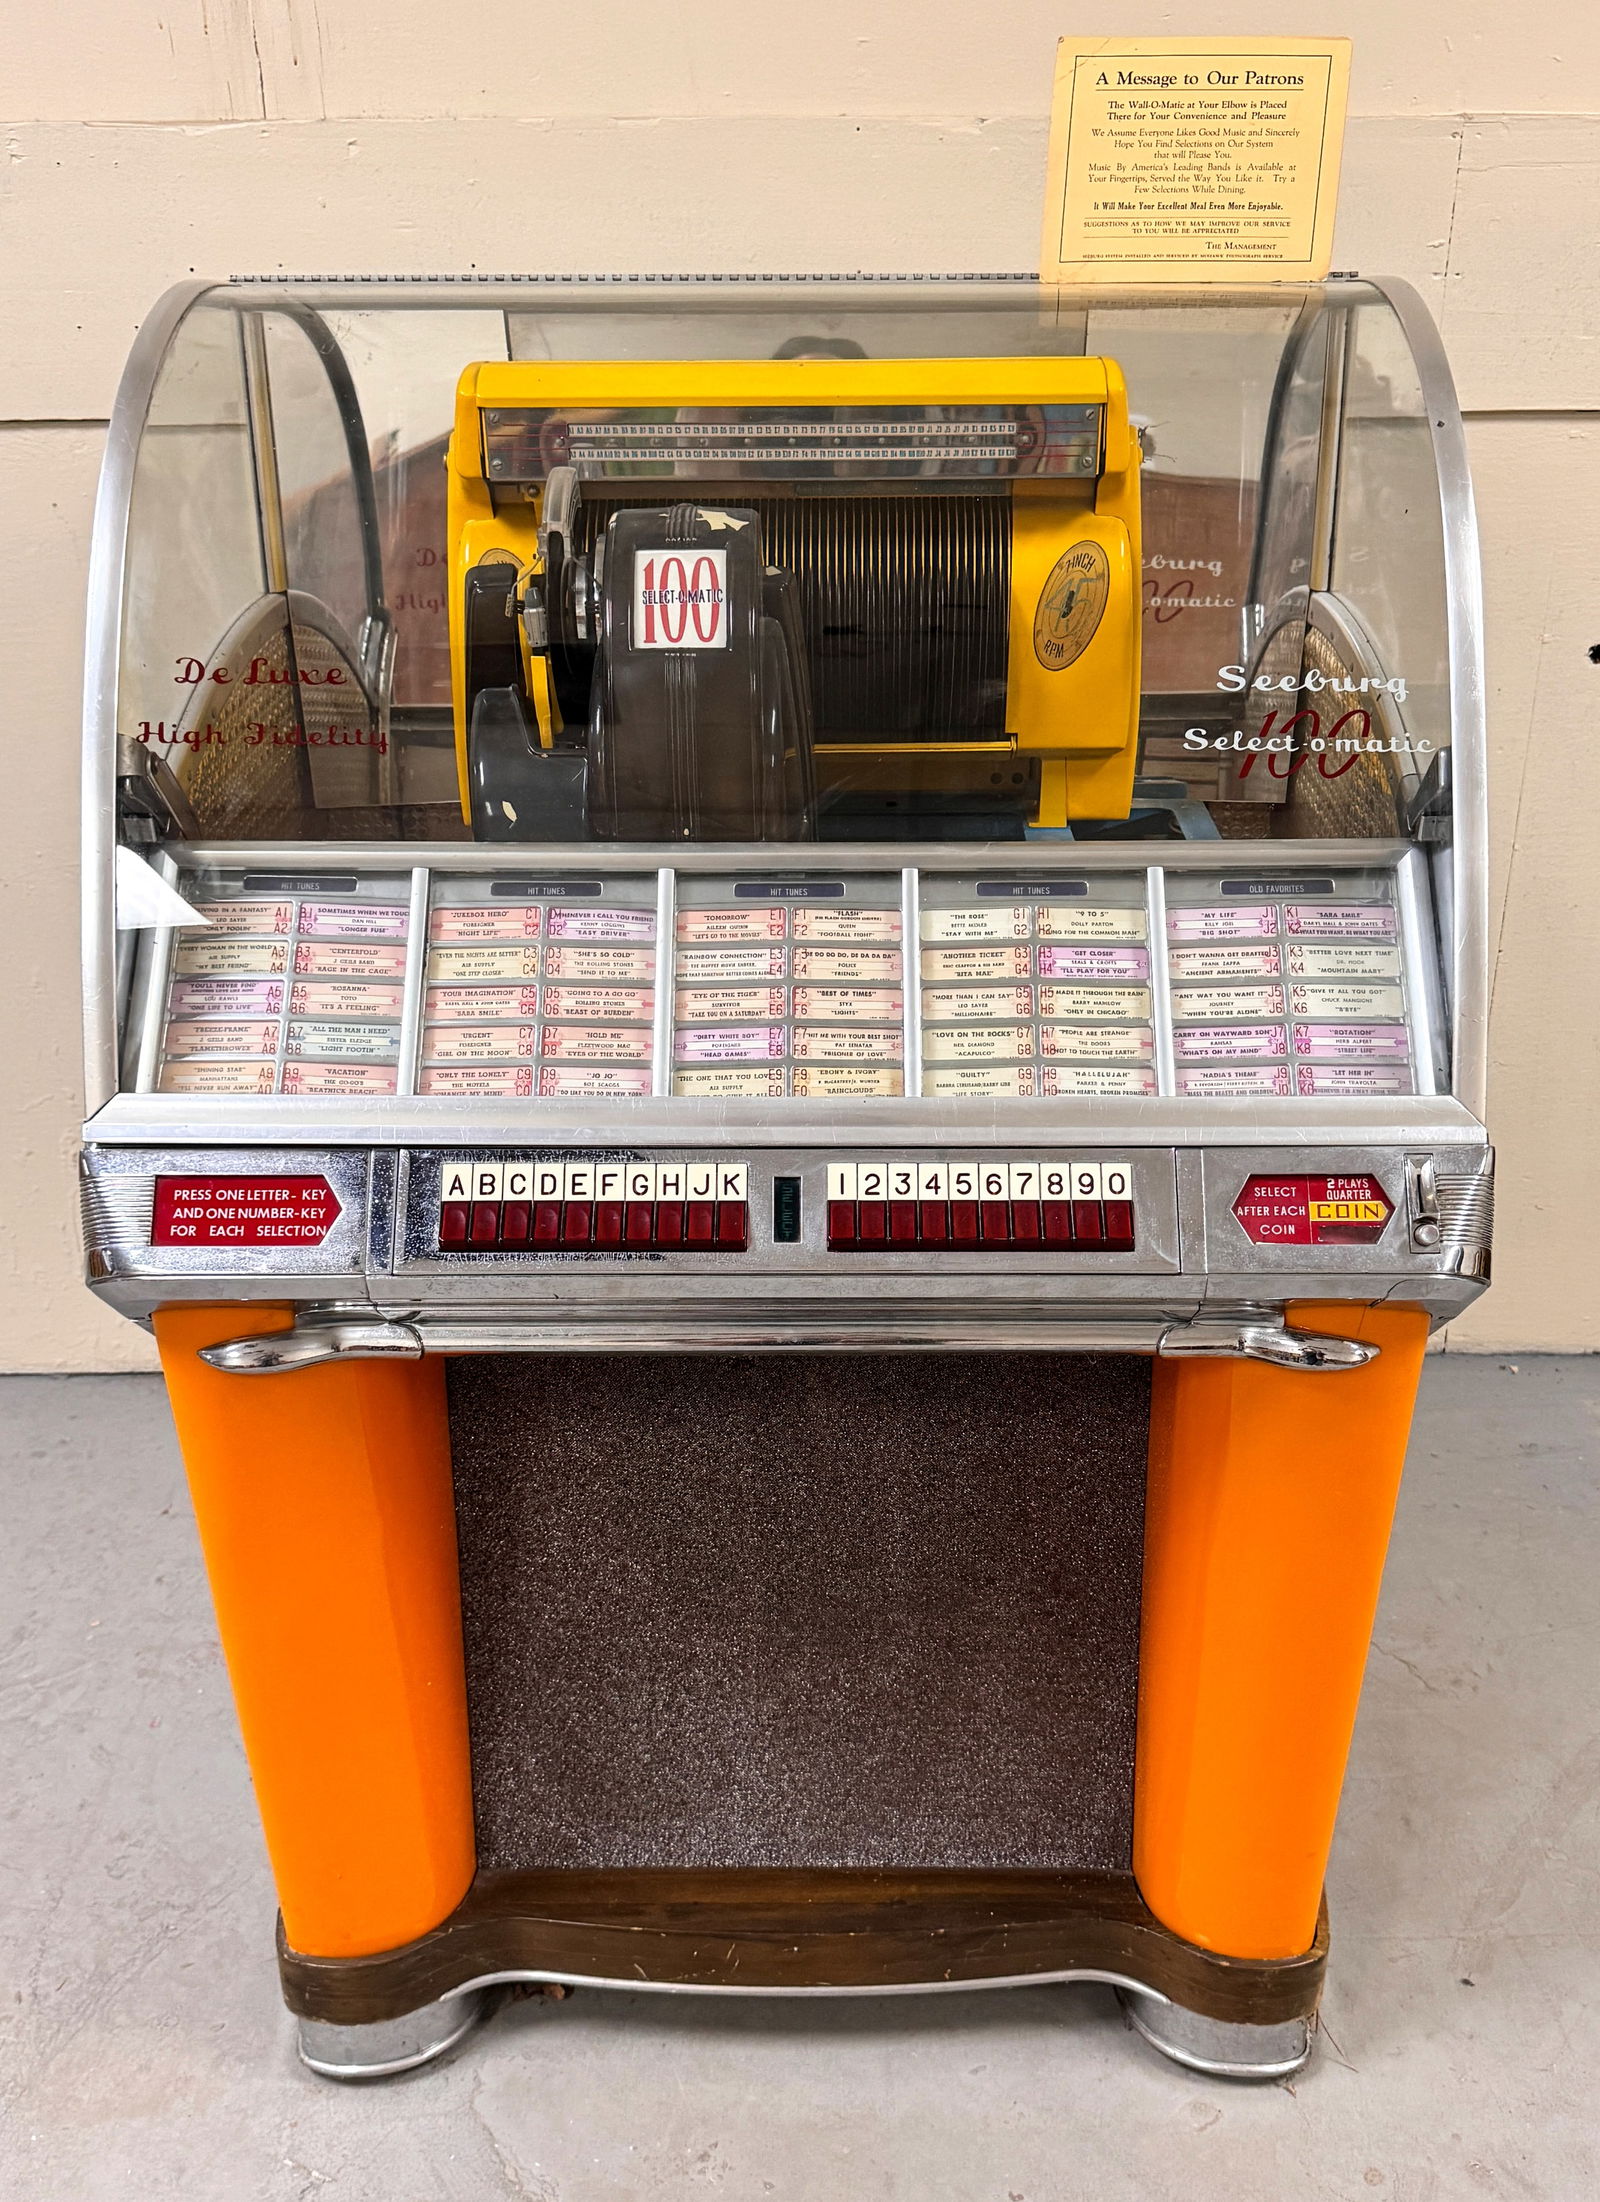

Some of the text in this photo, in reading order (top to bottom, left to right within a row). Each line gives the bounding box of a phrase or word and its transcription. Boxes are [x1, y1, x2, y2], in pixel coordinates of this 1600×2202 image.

[1095, 70, 1304, 87] A Message to Our Patrons
[1108, 101, 1125, 109] The
[1128, 100, 1185, 109] Wall-O-Matic
[1198, 100, 1219, 109] Your
[1221, 100, 1248, 109] Elbow
[1250, 101, 1257, 109] is
[1260, 100, 1287, 109] Placed
[1107, 111, 1286, 121] There for Your Convenience and Pleasure
[1091, 127, 1300, 138] We Assume Everyone Likes Good Music and Sincerely
[1114, 139, 1135, 150] Hope
[1137, 139, 1153, 148] You
[1155, 139, 1173, 148] Find
[1175, 139, 1213, 148] Selections
[1227, 139, 1244, 148] Our
[1246, 139, 1273, 149] System
[1154, 150, 1232, 159] that will Please You.
[1094, 201, 1283, 212] It Will Make Your Excellent Meal Even More Enjoyable.
[1205, 241, 1277, 250] THE MANAGEMENT
[643, 557, 720, 643] 100
[1044, 640, 1064, 658] RPM
[174, 657, 348, 686] De Luxe
[1216, 665, 1409, 701] Seeburg
[136, 722, 388, 754] High Fidelity
[1238, 709, 1371, 779] 100
[297, 882, 320, 890] TUNES
[1250, 885, 1304, 893] OLD FAVORITES
[525, 909, 538, 919] C1
[1262, 907, 1273, 918] J1
[299, 923, 313, 933] B2
[549, 949, 562, 959] D3
[1039, 948, 1052, 958] H3
[522, 988, 535, 998] C5
[770, 988, 782, 998] E5
[794, 988, 807, 998] F5
[1292, 986, 1307, 997] K5
[263, 1027, 277, 1037] A7
[449, 1174, 740, 1196] A B C D E F G H J K
[840, 1173, 1124, 1195] 1 2 3 4 5 6 7 8 9 0
[1326, 1178, 1369, 1189] 2 PLAYS
[174, 1189, 212, 1200] PRESS
[216, 1189, 245, 1200] ONE
[302, 1189, 327, 1200] KEY
[1254, 1187, 1297, 1198] SELECT
[1326, 1189, 1372, 1200] QUARTER
[173, 1207, 204, 1219] AND
[206, 1208, 235, 1219] ONE
[1237, 1205, 1306, 1216] AFTER EACH
[1317, 1203, 1381, 1219] COIN
[170, 1225, 325, 1237] FOR EACH SELECTION
[1260, 1224, 1295, 1235] COIN
